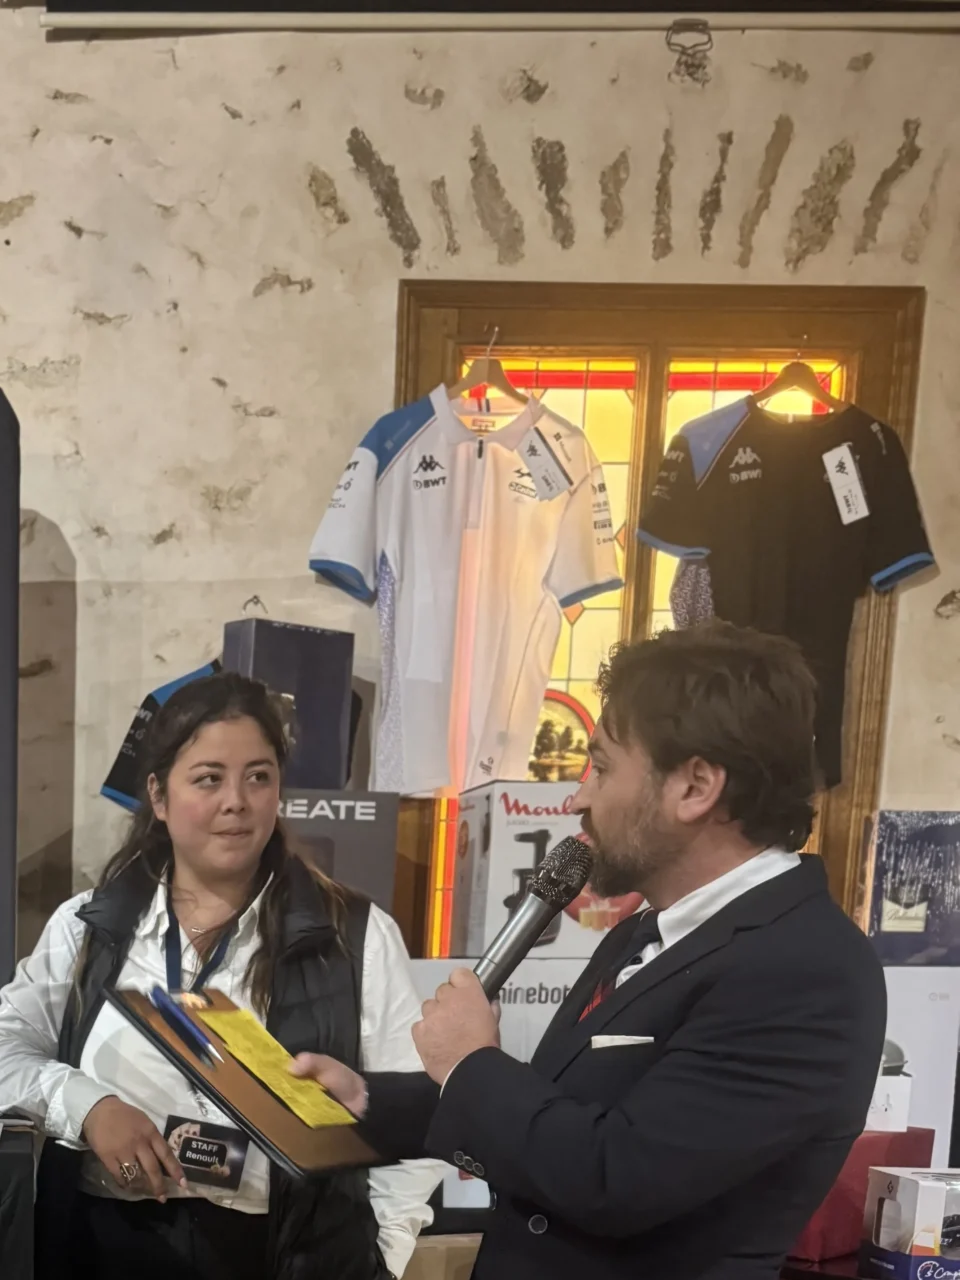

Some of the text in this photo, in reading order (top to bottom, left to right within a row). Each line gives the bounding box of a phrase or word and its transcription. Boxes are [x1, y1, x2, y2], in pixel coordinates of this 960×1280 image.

[423, 476, 447, 489] BWT
[191, 1141, 220, 1152] STAFF
[185, 1151, 220, 1163] Renault
